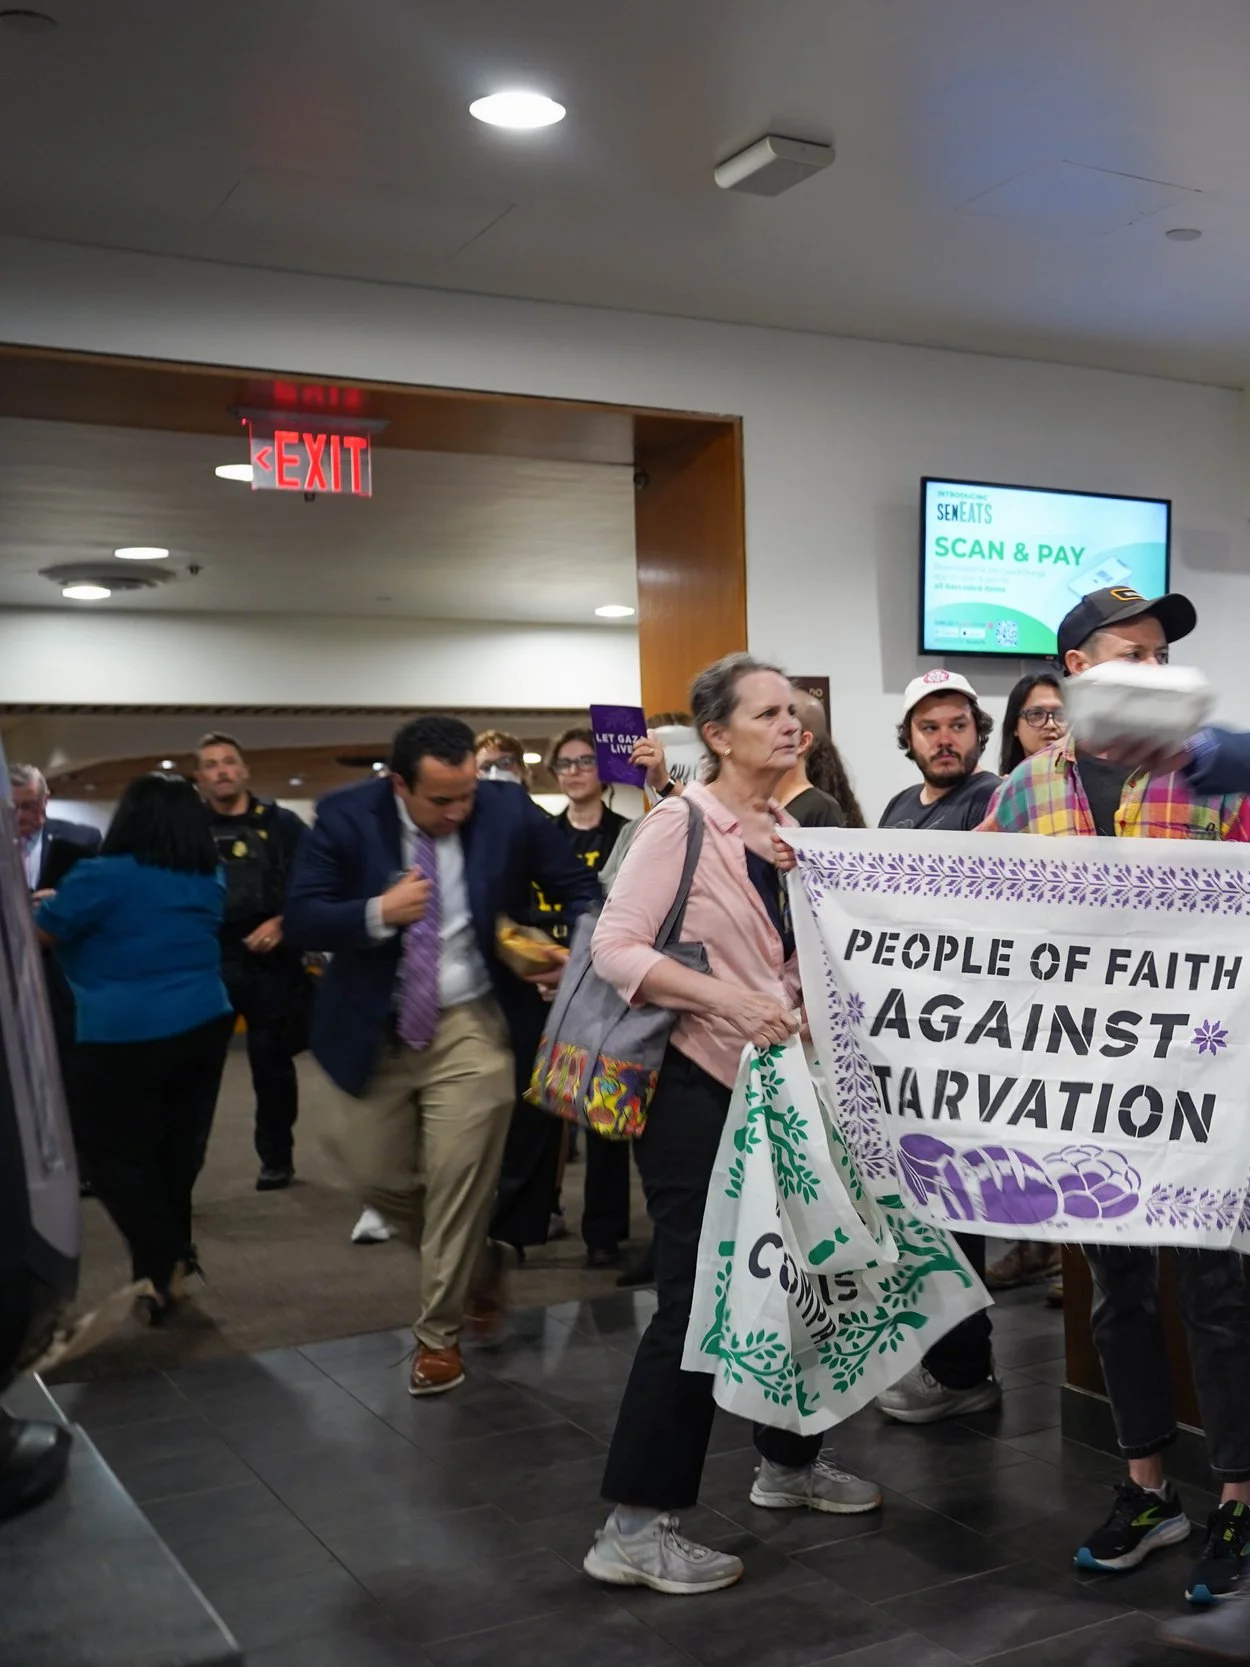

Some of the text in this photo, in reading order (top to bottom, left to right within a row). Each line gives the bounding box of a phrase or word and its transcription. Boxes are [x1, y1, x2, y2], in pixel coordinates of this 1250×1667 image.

[274, 431, 368, 493] EXIT
[934, 536, 1086, 567] SCAN & PAY
[595, 733, 639, 744] LET GAZ
[610, 743, 633, 754] LIVE
[843, 928, 1243, 991] PEOPLE OF FAITH
[869, 988, 1190, 1059] AGAINST
[871, 1064, 1217, 1143] TARVATION
